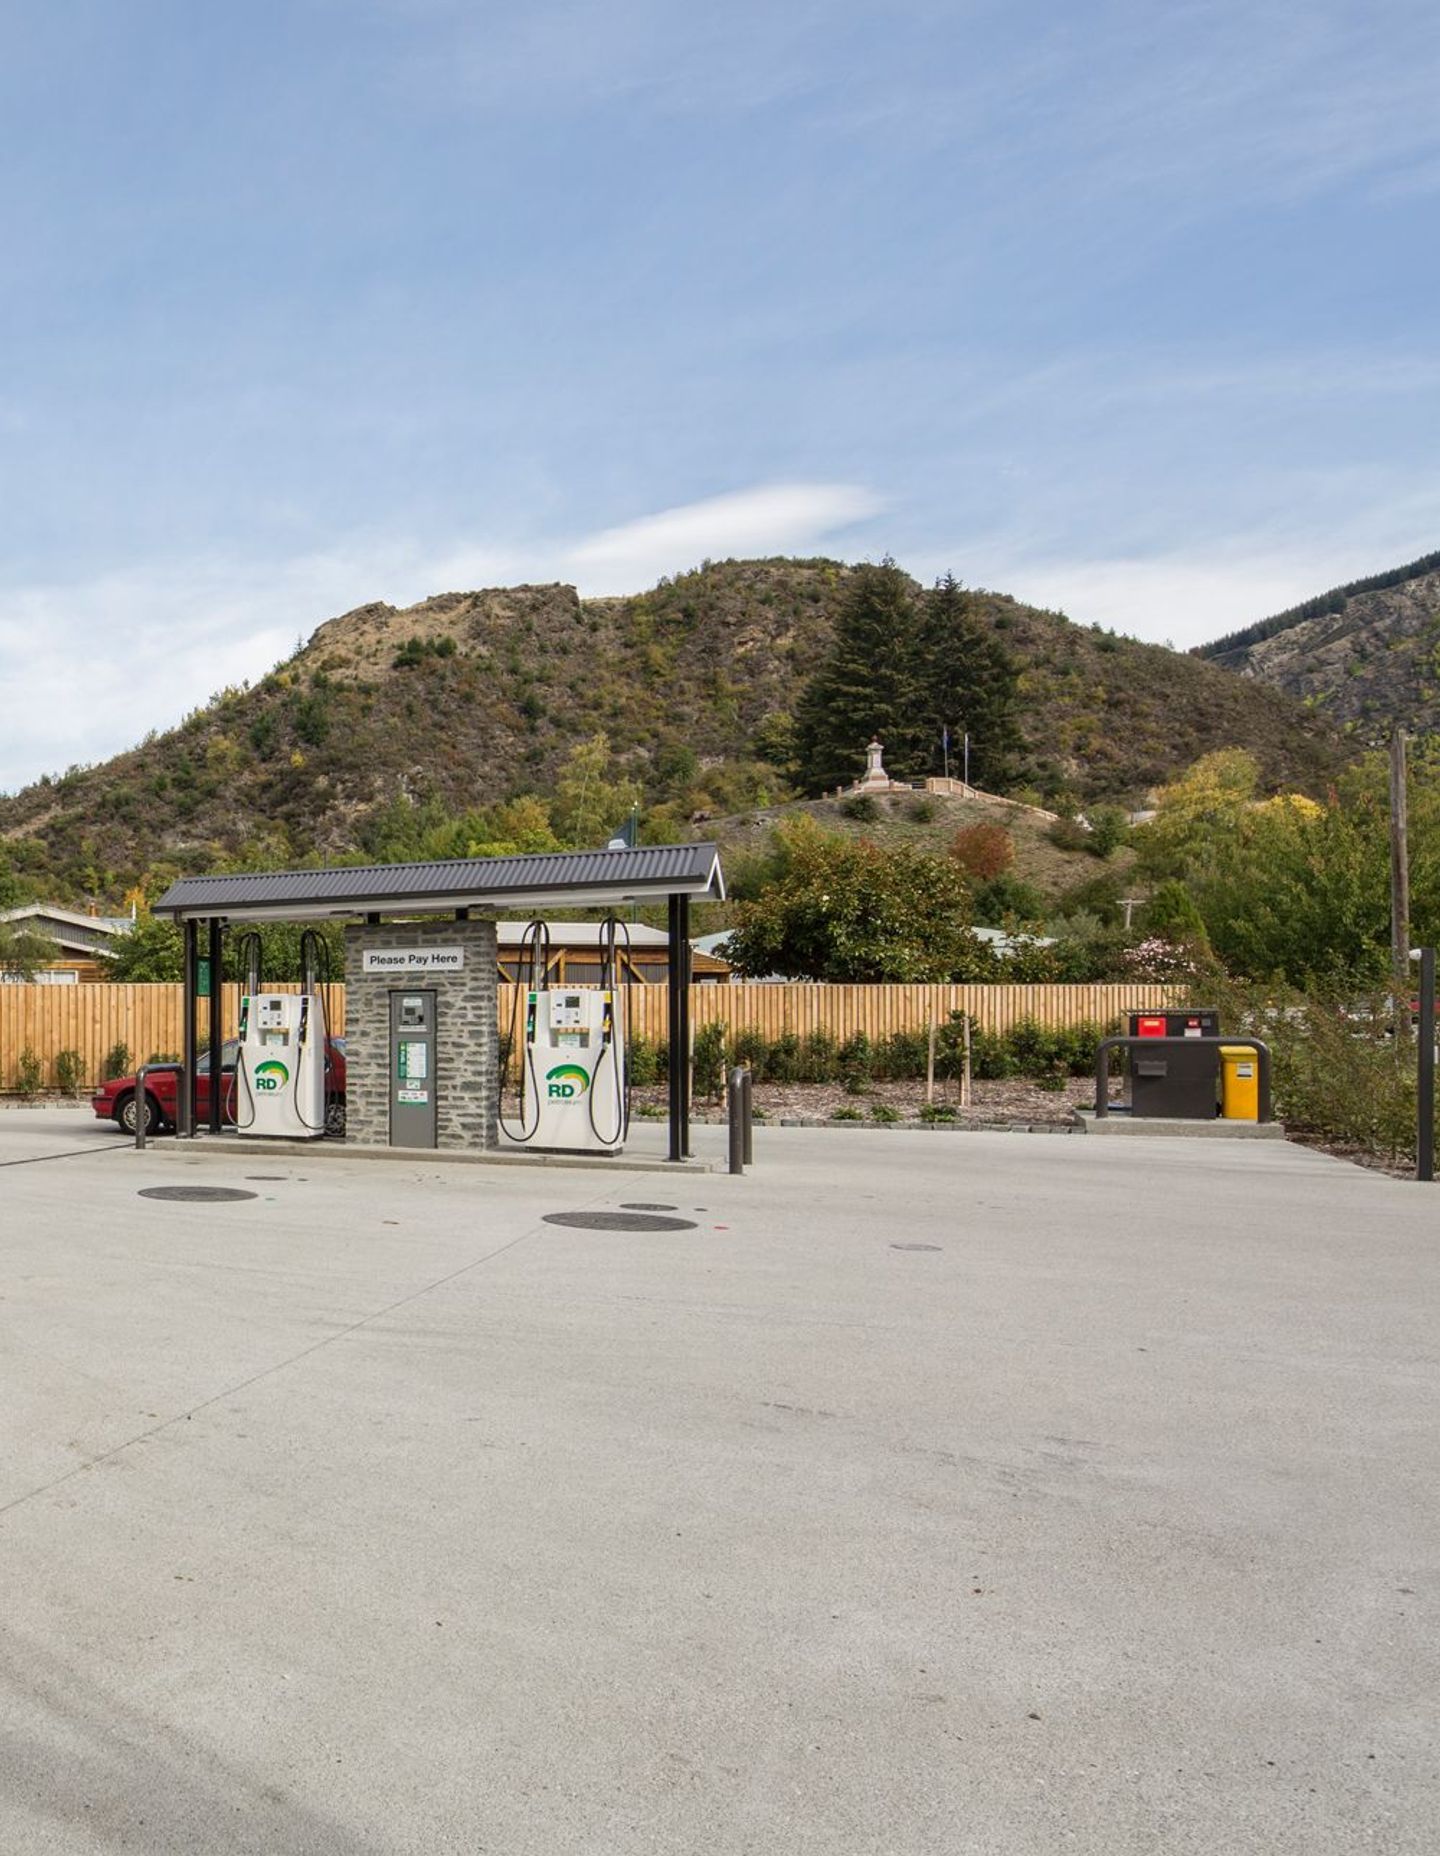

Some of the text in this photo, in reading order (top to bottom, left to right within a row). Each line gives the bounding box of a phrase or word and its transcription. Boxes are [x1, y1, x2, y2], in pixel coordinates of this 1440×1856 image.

[369, 953, 458, 966] Please Pay Here
[256, 1078, 277, 1090] RD
[548, 1084, 575, 1098] RD
